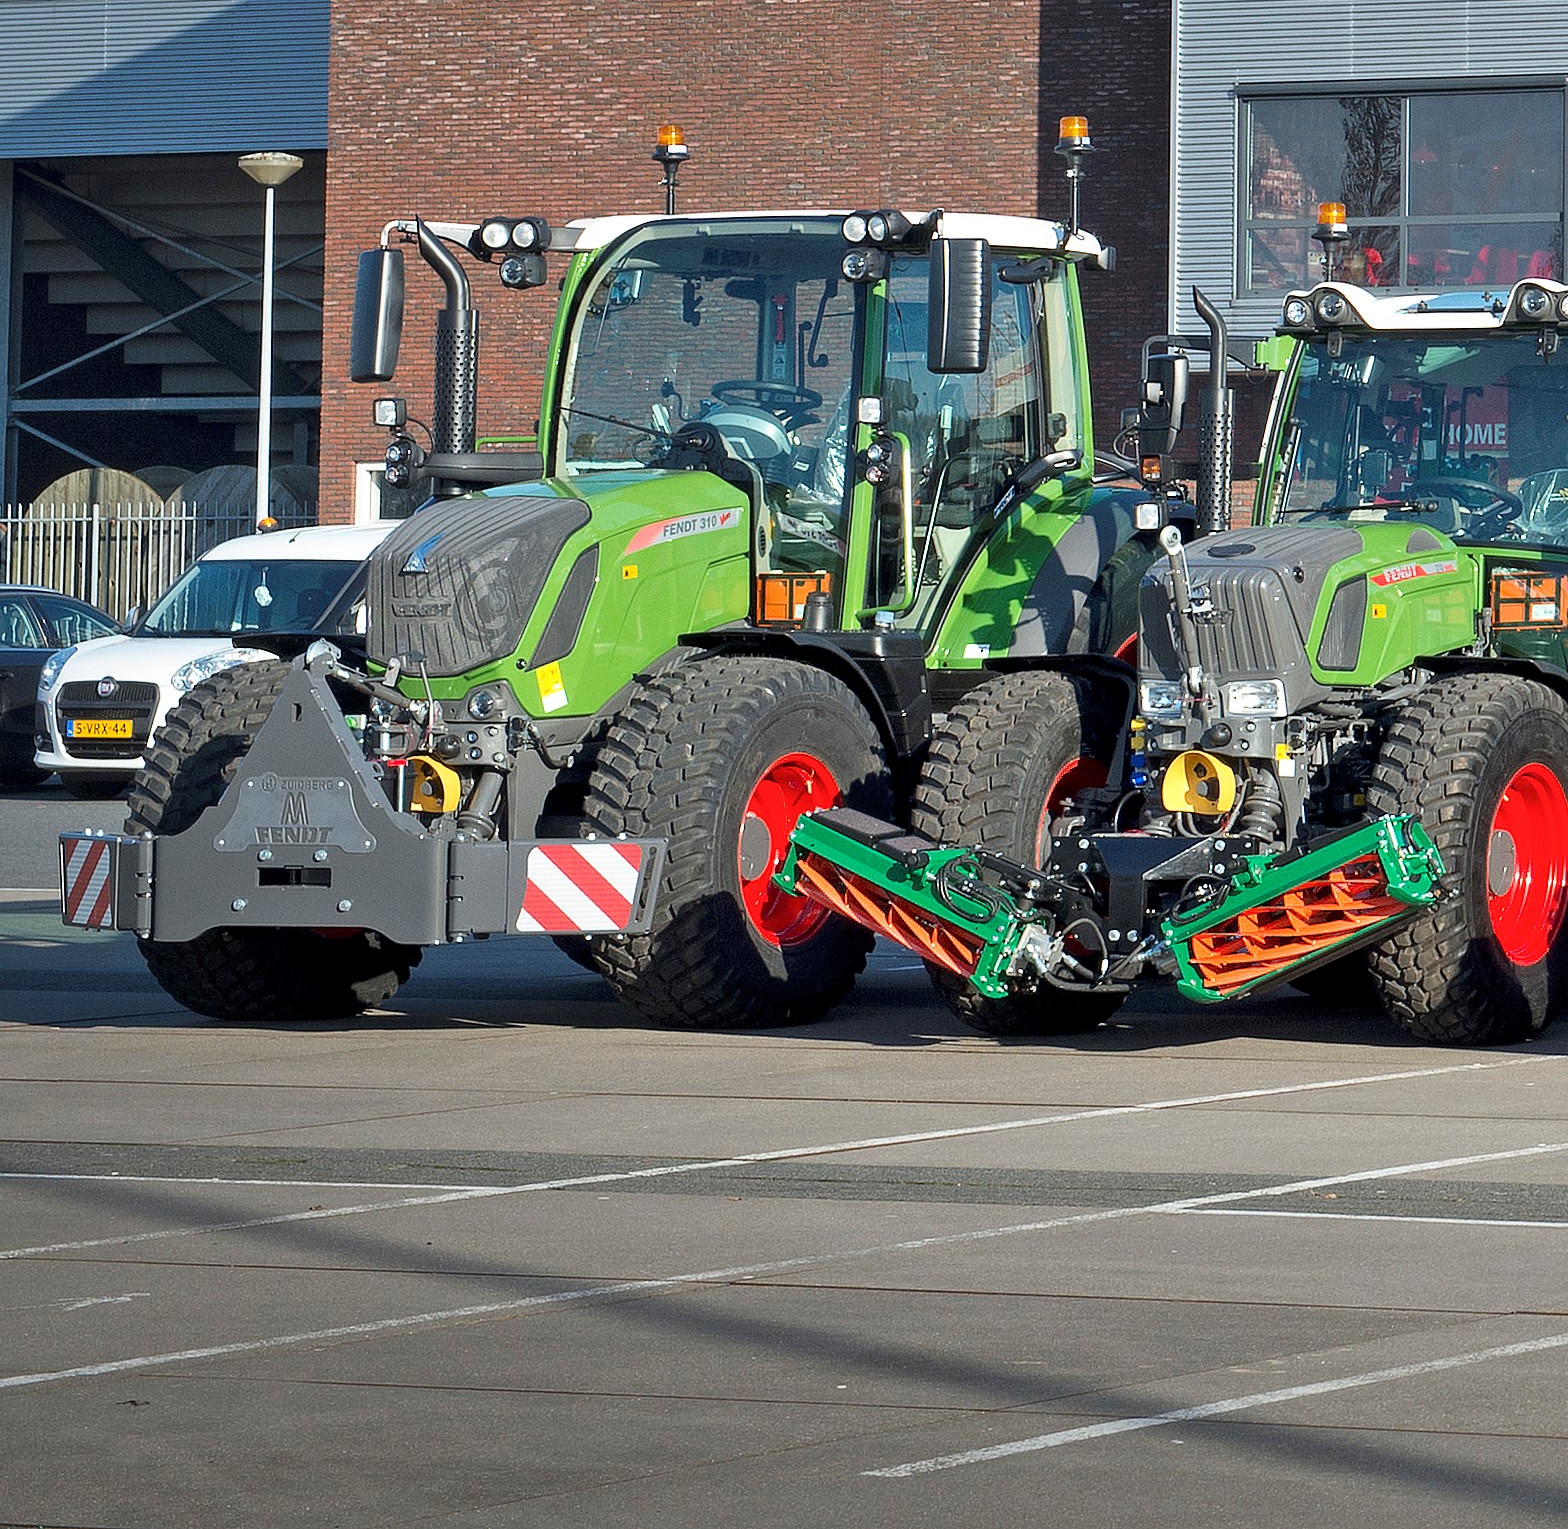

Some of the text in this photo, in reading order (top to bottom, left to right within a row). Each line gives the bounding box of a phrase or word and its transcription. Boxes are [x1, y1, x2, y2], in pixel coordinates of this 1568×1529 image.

[663, 519, 697, 537] FENDT
[700, 515, 717, 529] 310
[280, 779, 334, 791] ZUIDBERG
[254, 827, 333, 843] FENDT
